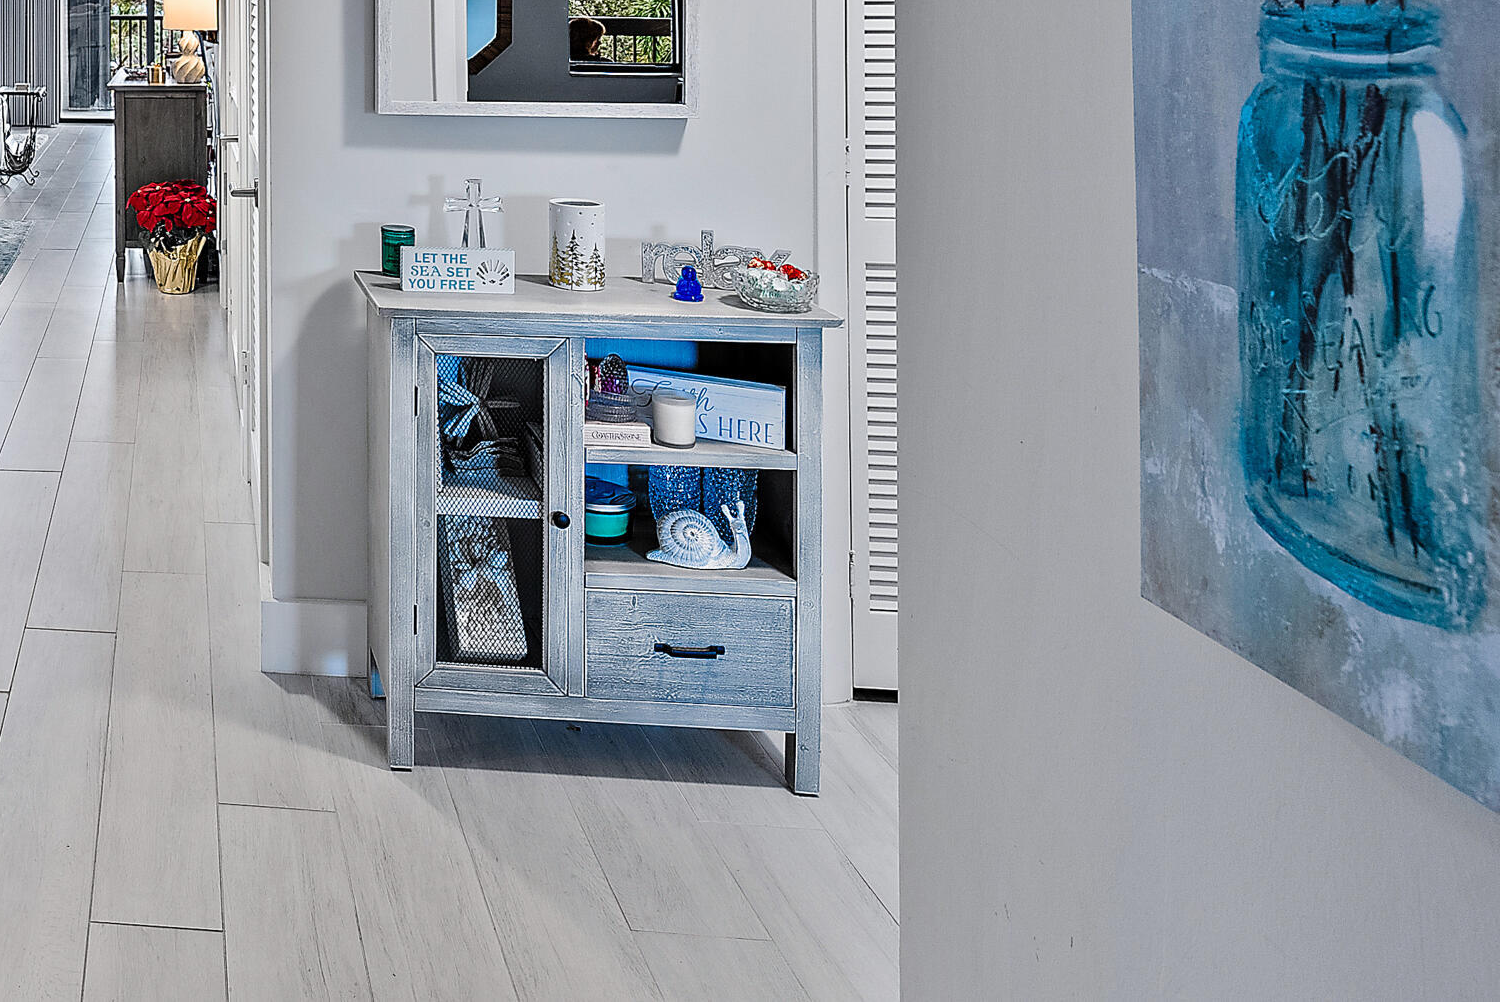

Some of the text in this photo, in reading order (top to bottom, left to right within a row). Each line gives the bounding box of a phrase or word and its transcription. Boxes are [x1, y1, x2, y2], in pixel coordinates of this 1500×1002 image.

[414, 253, 468, 264] LET THE
[410, 265, 472, 278] SEA SET
[408, 278, 476, 291] YOU FREE
[718, 416, 774, 445] HERE
